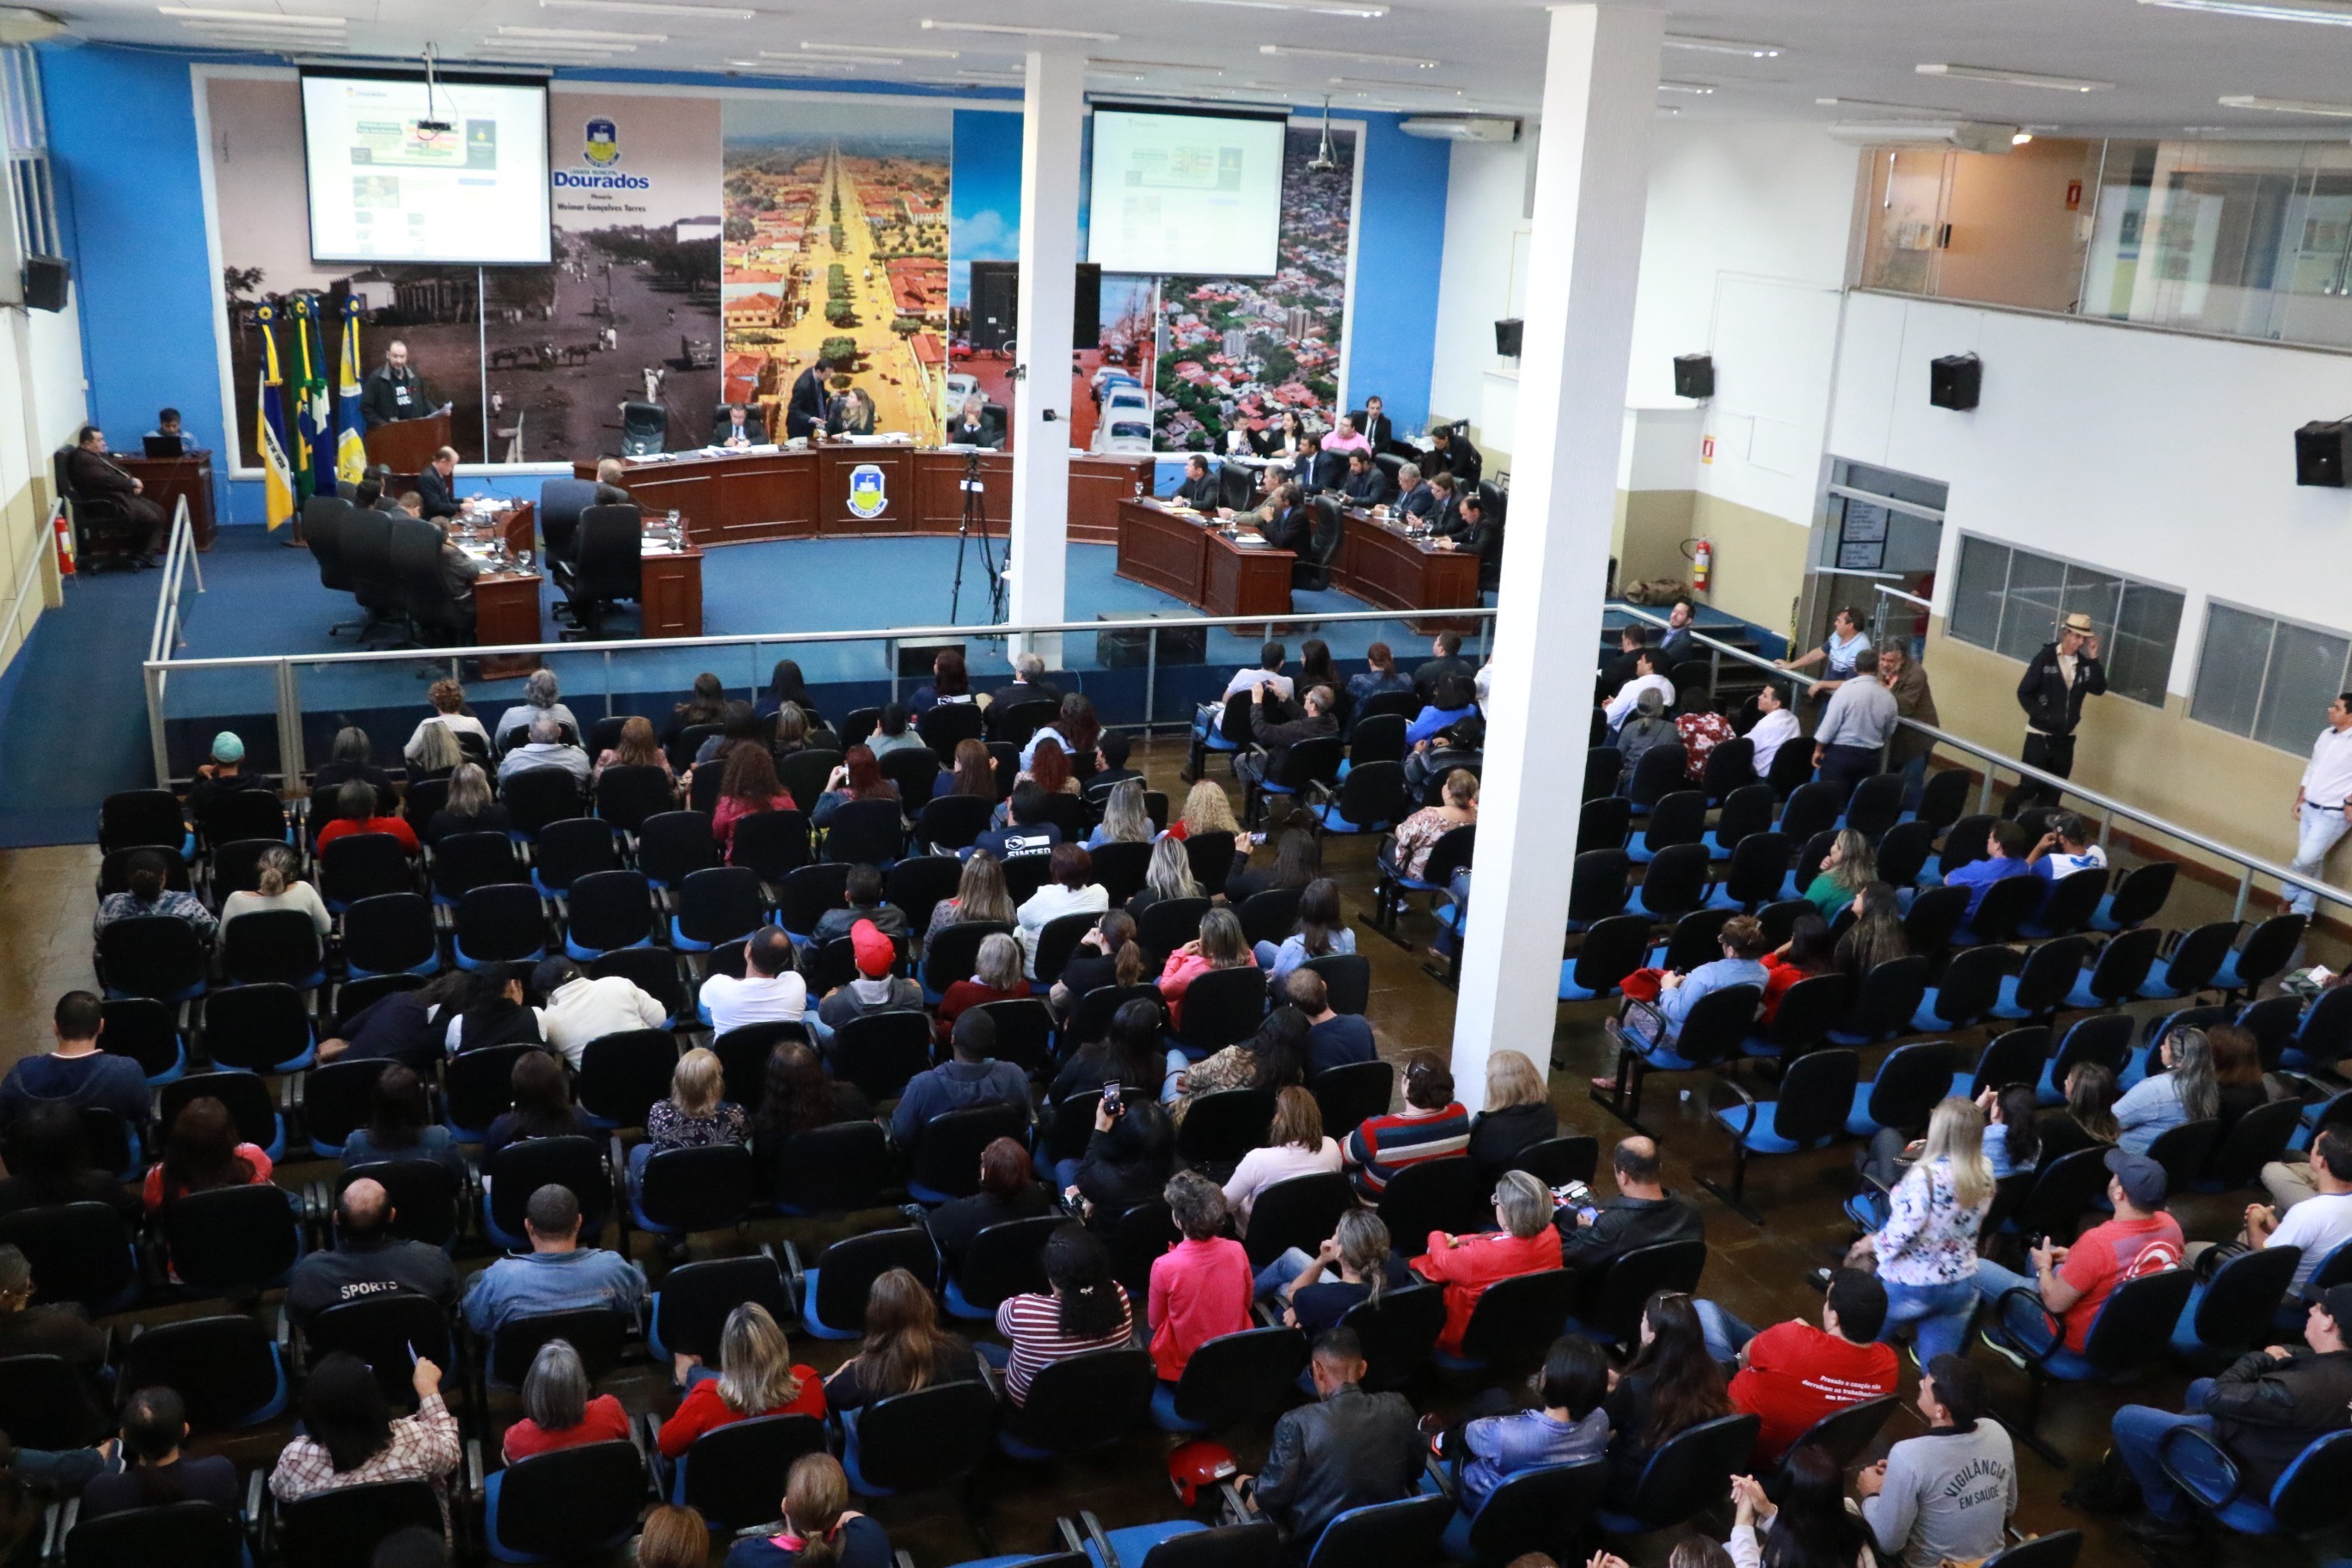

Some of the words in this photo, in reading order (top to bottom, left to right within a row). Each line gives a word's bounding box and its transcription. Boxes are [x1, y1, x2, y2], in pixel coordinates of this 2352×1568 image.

[554, 171, 650, 189] Dourados
[557, 203, 585, 211] Weimar
[586, 204, 622, 213] Gonçalves
[340, 1281, 398, 1300] SPORTS
[1802, 1379, 1834, 1392] derrubam
[1820, 1375, 1844, 1386] Pressão
[1944, 1458, 2006, 1498] VIGILÂNCIA
[1959, 1495, 1974, 1510] EM
[1975, 1485, 2000, 1504] SAÚDE
